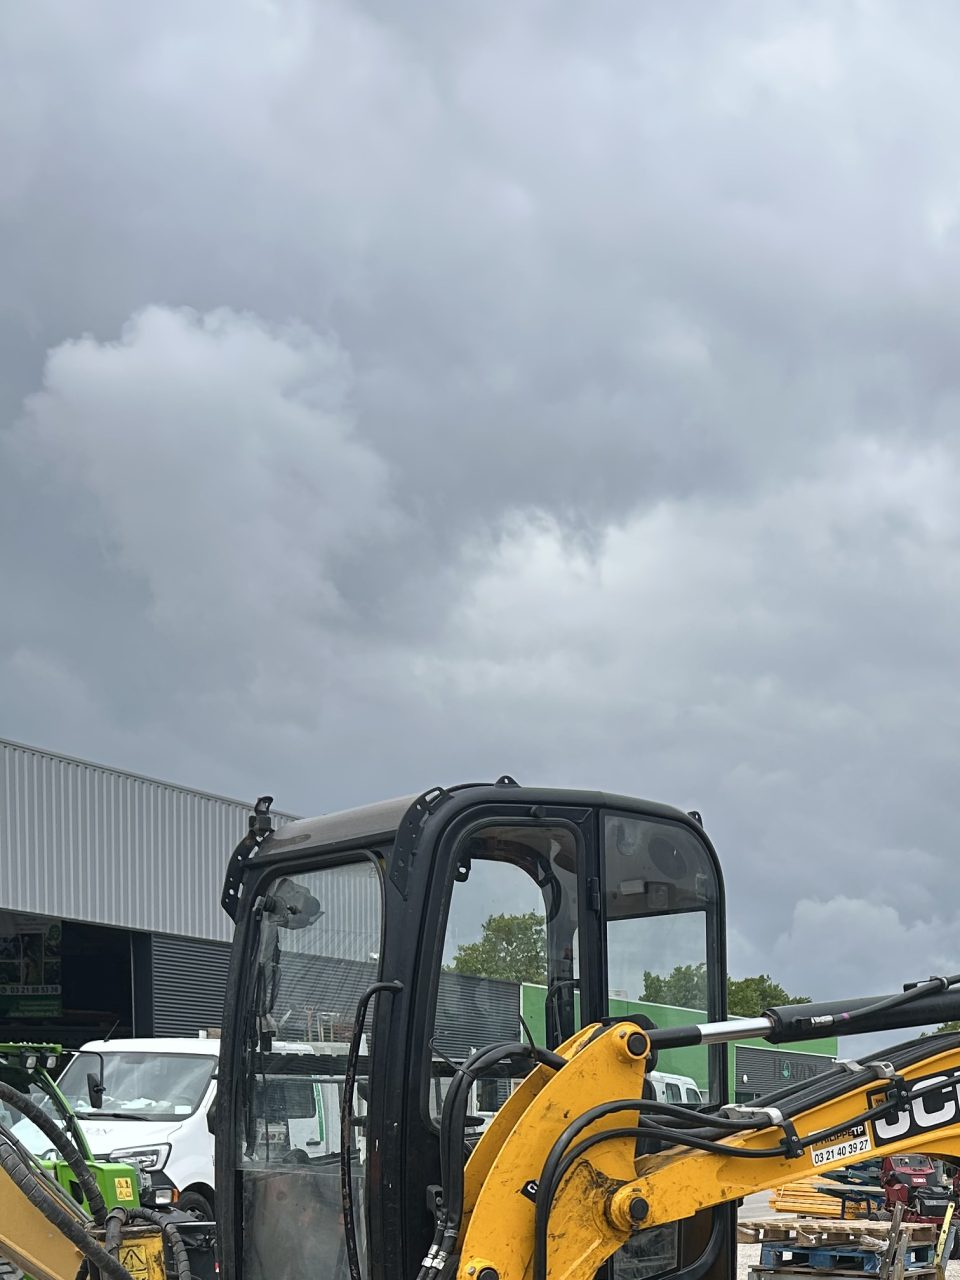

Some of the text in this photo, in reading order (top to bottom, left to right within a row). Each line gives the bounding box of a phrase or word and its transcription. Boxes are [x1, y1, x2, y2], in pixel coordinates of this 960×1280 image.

[814, 1139, 869, 1164] 03 21 40 39 27
